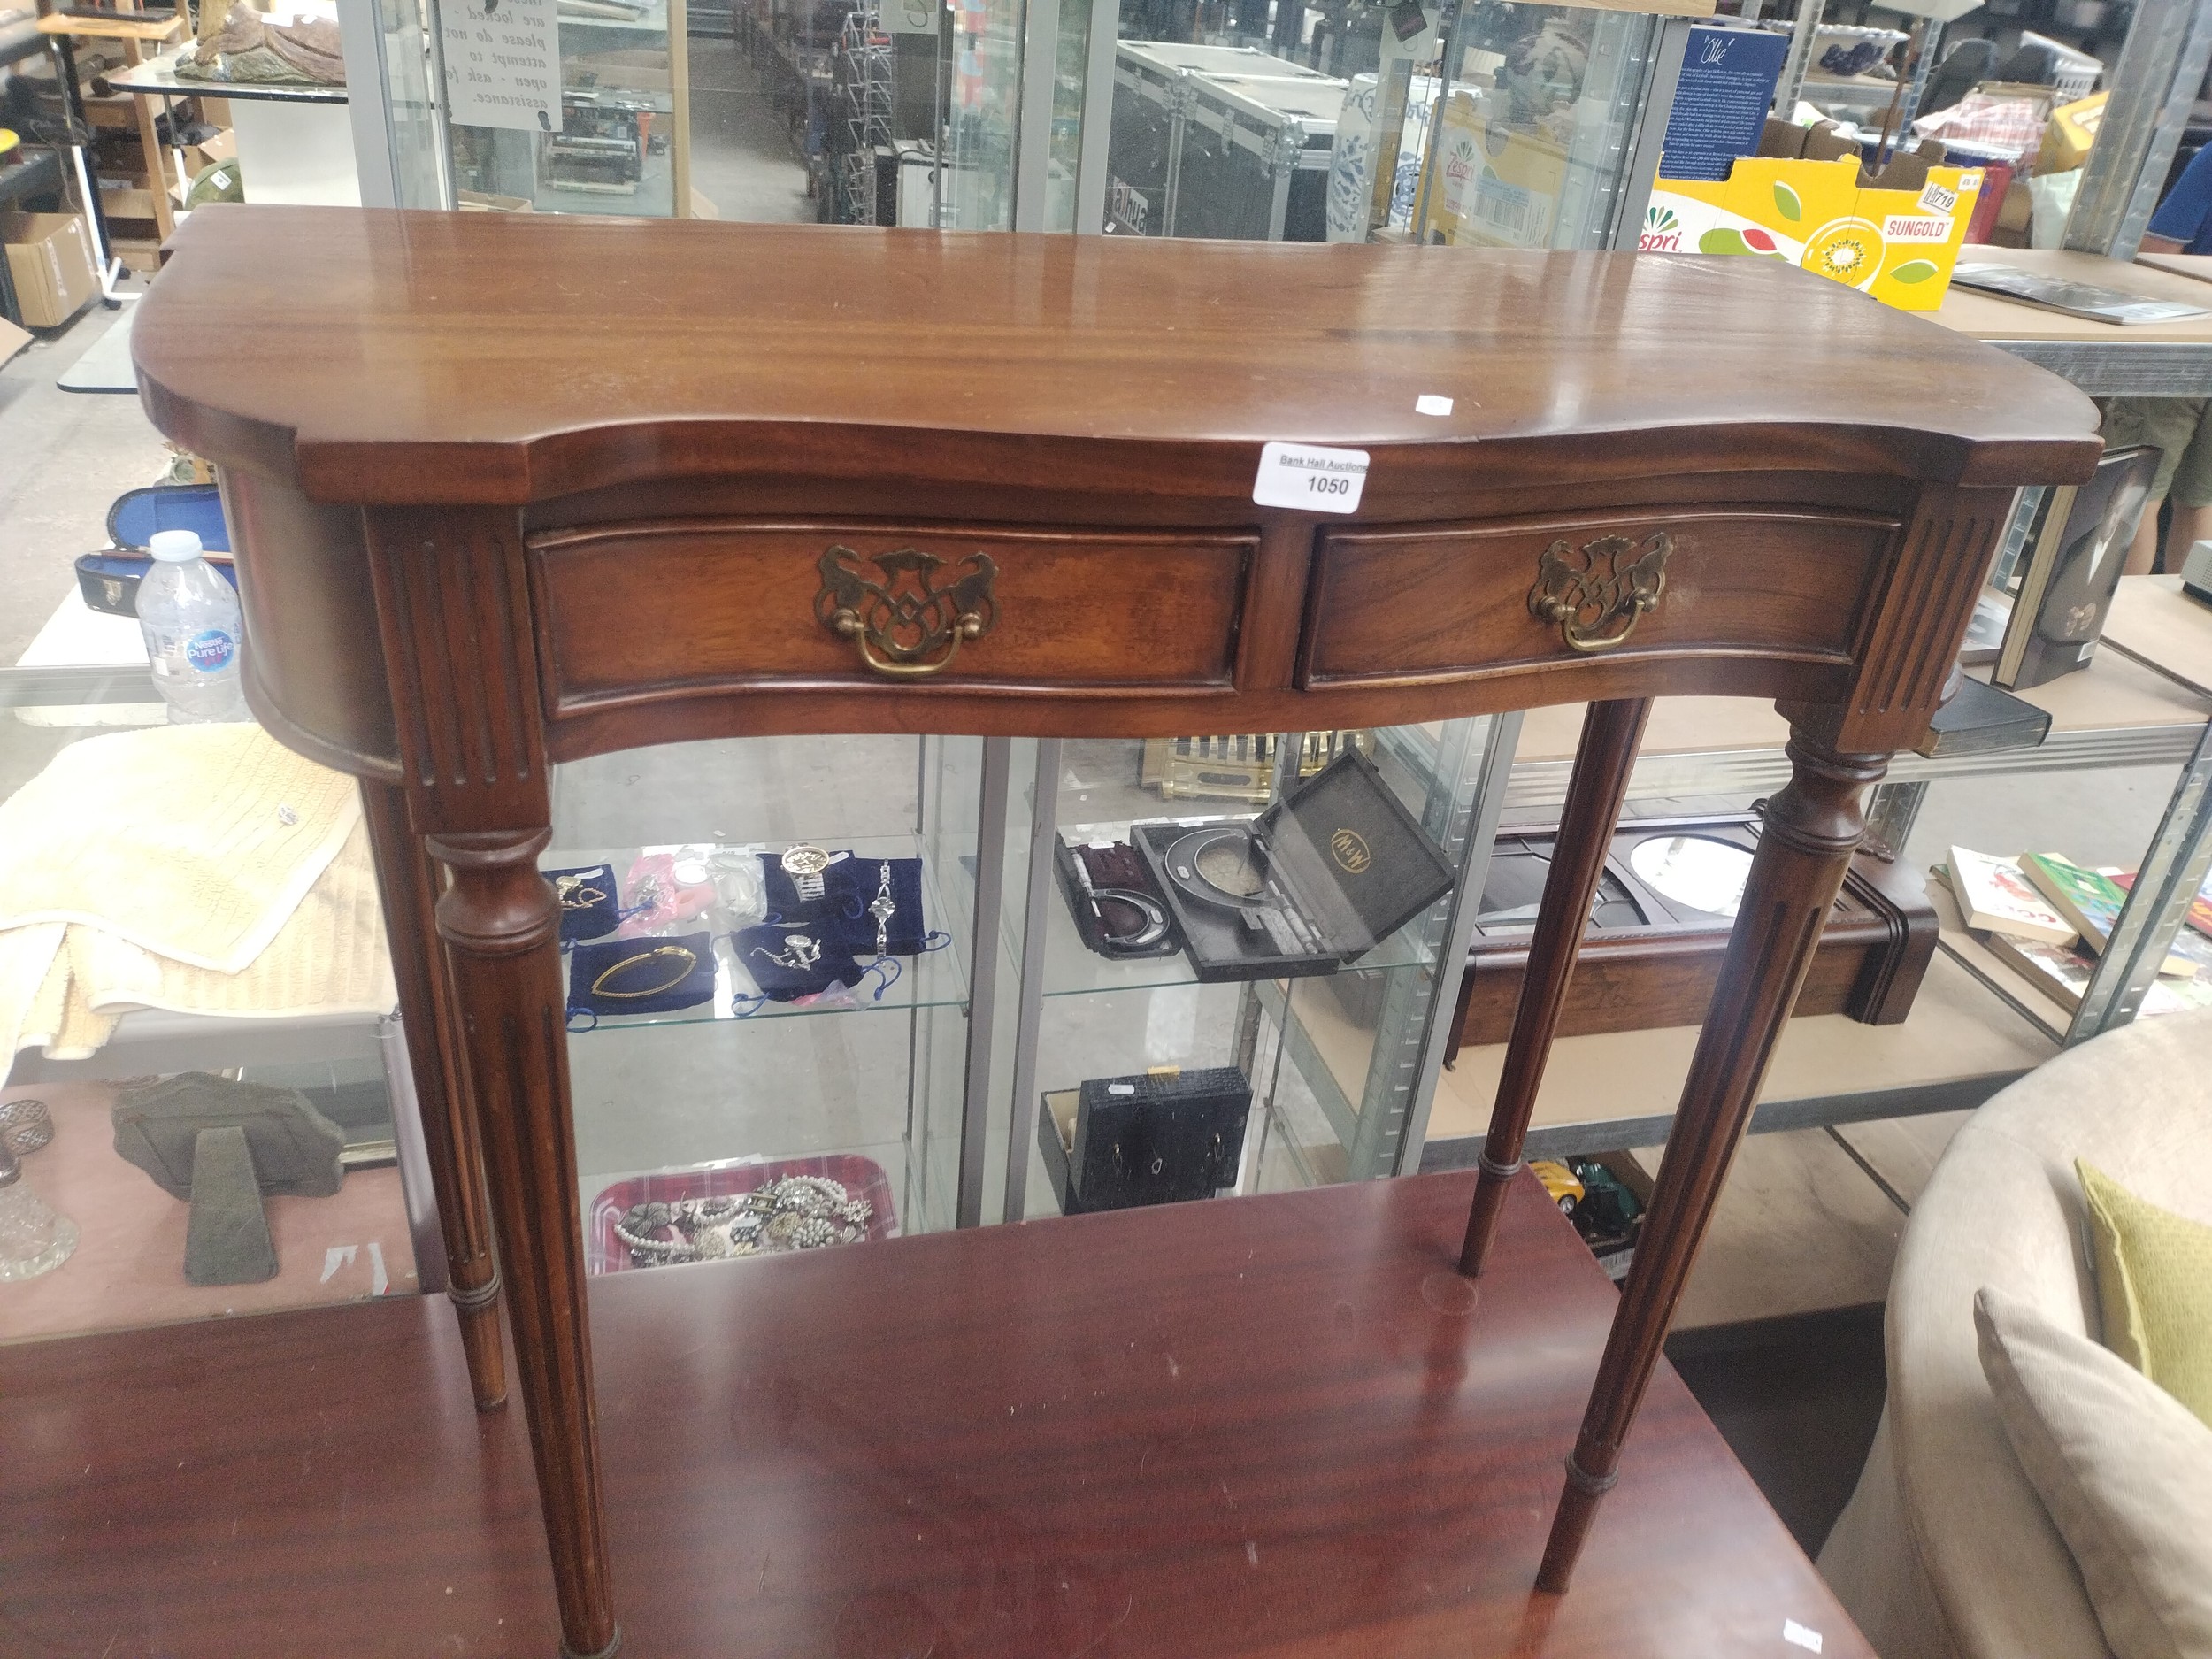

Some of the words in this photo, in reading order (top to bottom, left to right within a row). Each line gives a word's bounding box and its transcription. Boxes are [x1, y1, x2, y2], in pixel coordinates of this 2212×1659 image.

[1935, 192, 1954, 208] 719
[1638, 232, 1682, 252] spri
[1280, 455, 1304, 466] Bank
[1307, 458, 1326, 469] Hall
[1308, 476, 1349, 495] 1050
[188, 647, 216, 659] Pure
[216, 641, 234, 657] Life
